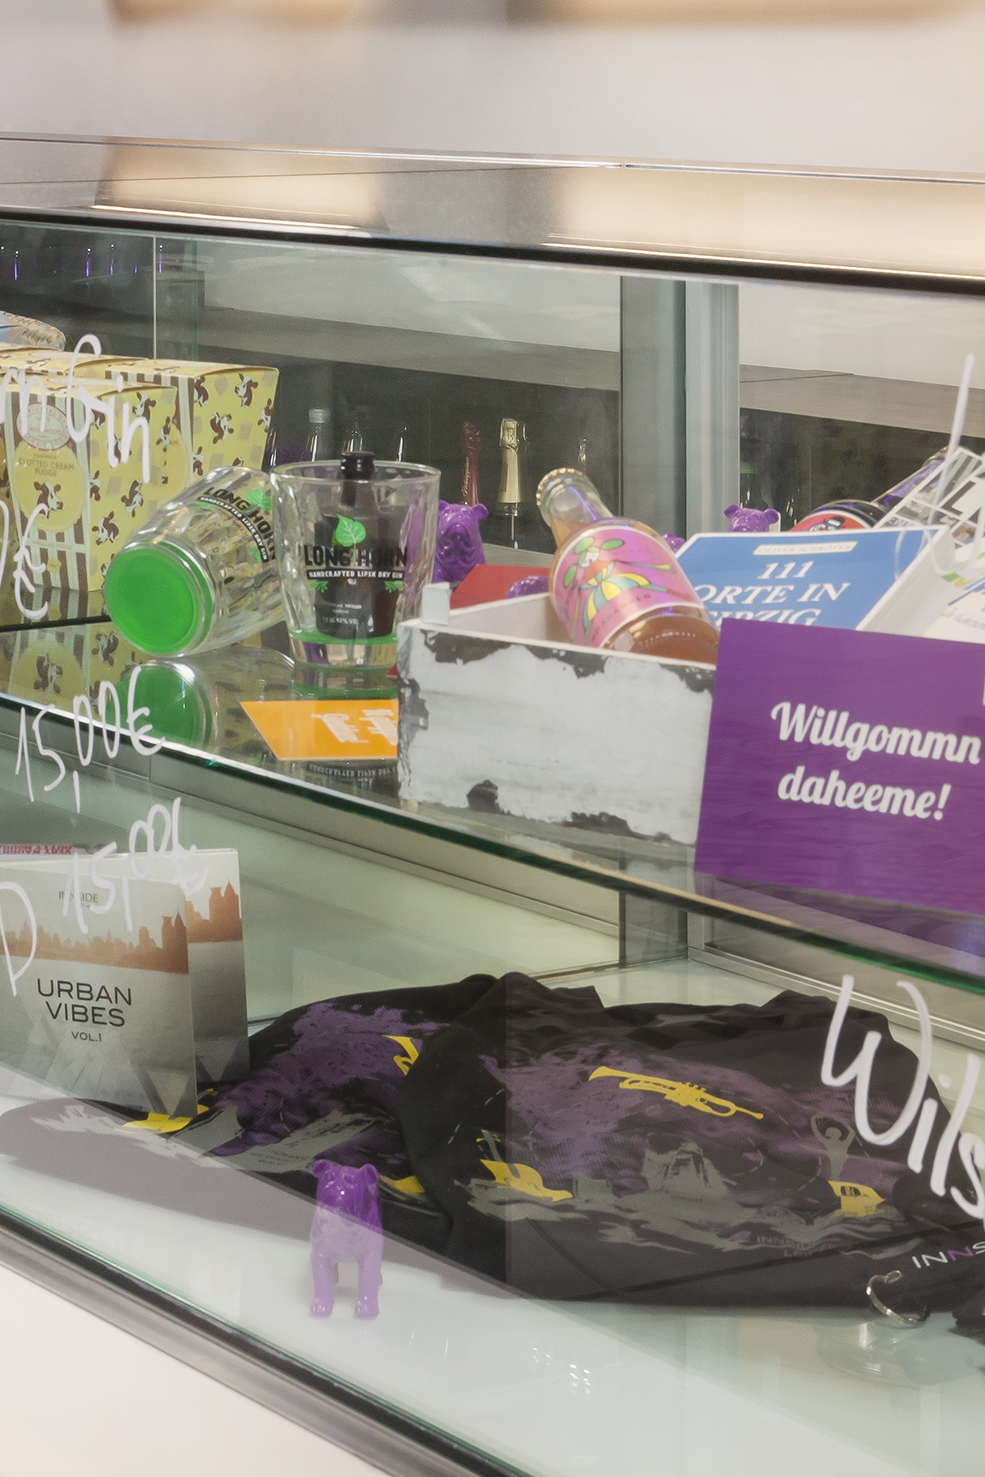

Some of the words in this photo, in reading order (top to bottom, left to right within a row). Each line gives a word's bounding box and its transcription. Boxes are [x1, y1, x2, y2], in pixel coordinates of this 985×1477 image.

[67, 334, 151, 484] Gin
[35, 468, 57, 477] FUDGE
[50, 462, 74, 471] CREAM
[757, 561, 814, 580] 111
[796, 582, 851, 602] IN
[15, 666, 165, 814] 15,00€
[771, 701, 981, 765] Willgommn
[777, 765, 951, 821] daheeme!
[37, 978, 132, 1006] URBAN
[46, 1001, 125, 1028] VIBES
[71, 1031, 102, 1042] VOL.1
